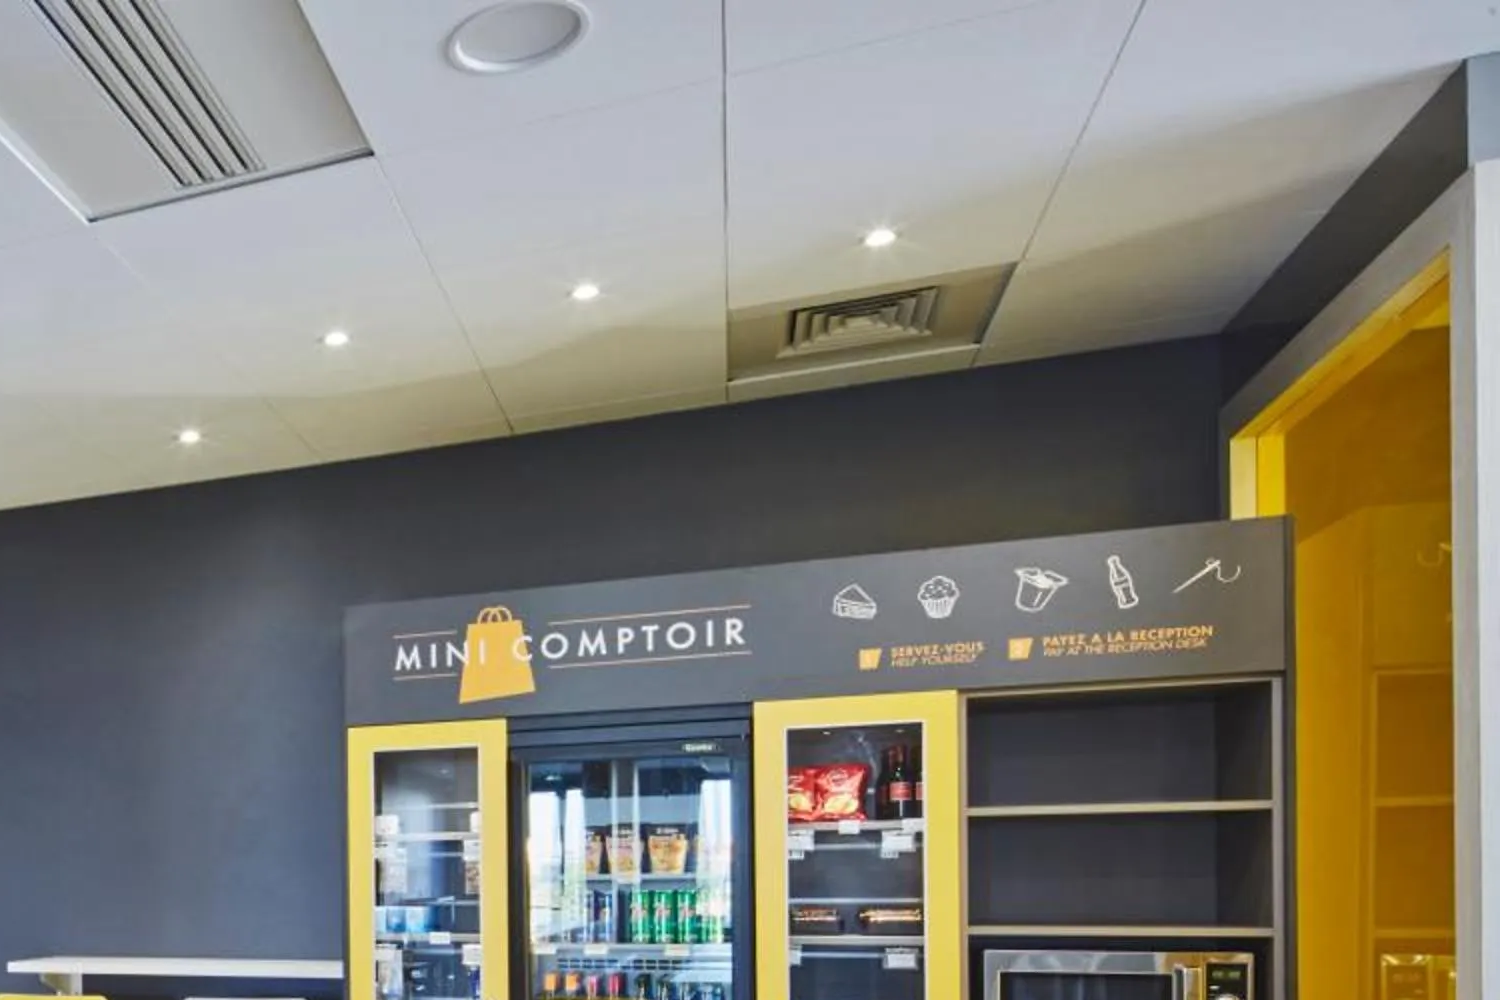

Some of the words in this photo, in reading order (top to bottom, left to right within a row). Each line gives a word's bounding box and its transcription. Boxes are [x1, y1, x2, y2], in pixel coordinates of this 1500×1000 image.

[394, 640, 486, 672] MINI
[512, 617, 746, 662] COMPTOIR
[1043, 633, 1085, 647] PAYEZ
[1091, 632, 1102, 644] A
[1107, 630, 1125, 643] LA
[1129, 625, 1214, 641] RECEPTION
[891, 641, 985, 658] SERVEZ-VOUS
